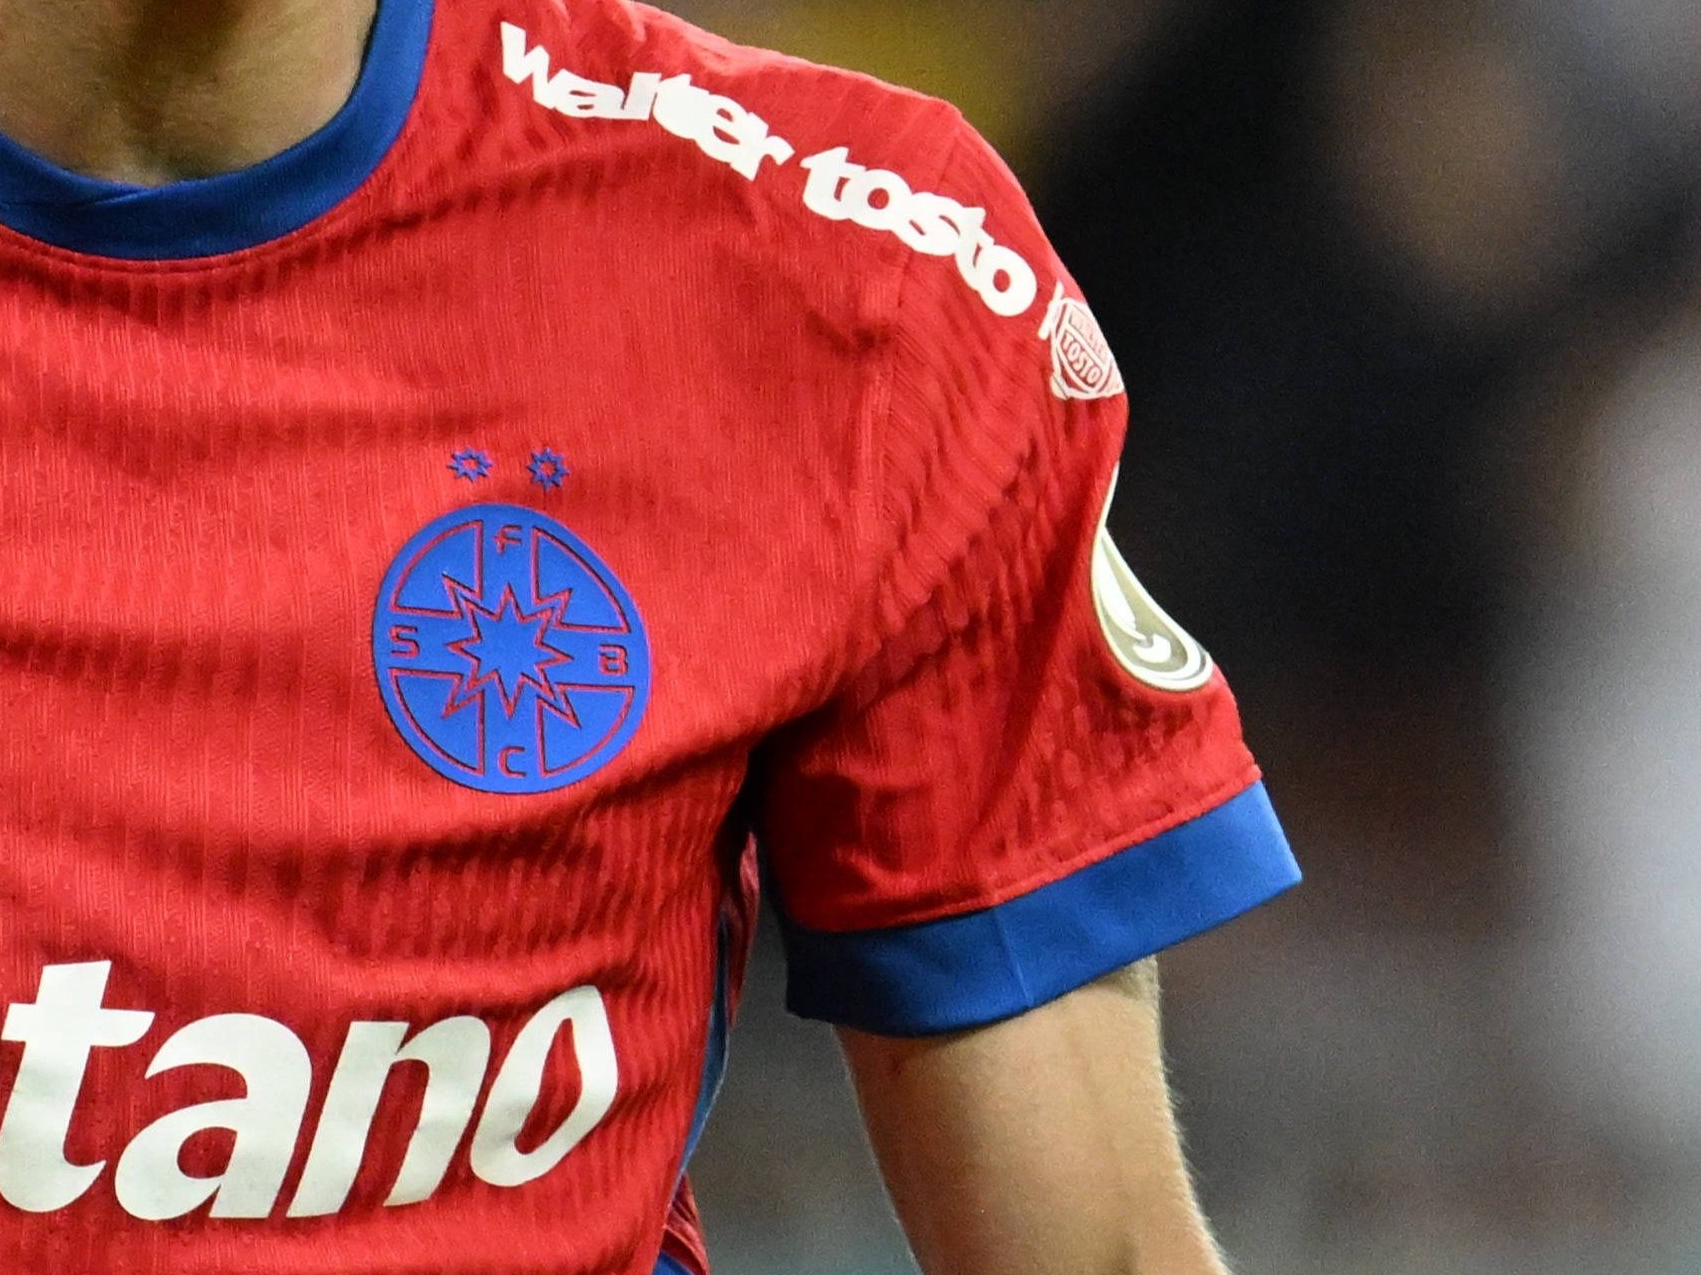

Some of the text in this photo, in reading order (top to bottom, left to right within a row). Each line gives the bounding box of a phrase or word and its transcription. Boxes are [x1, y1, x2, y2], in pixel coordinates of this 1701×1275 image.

[501, 22, 1037, 317] walter tosto
[1062, 331, 1102, 384] TOSTO
